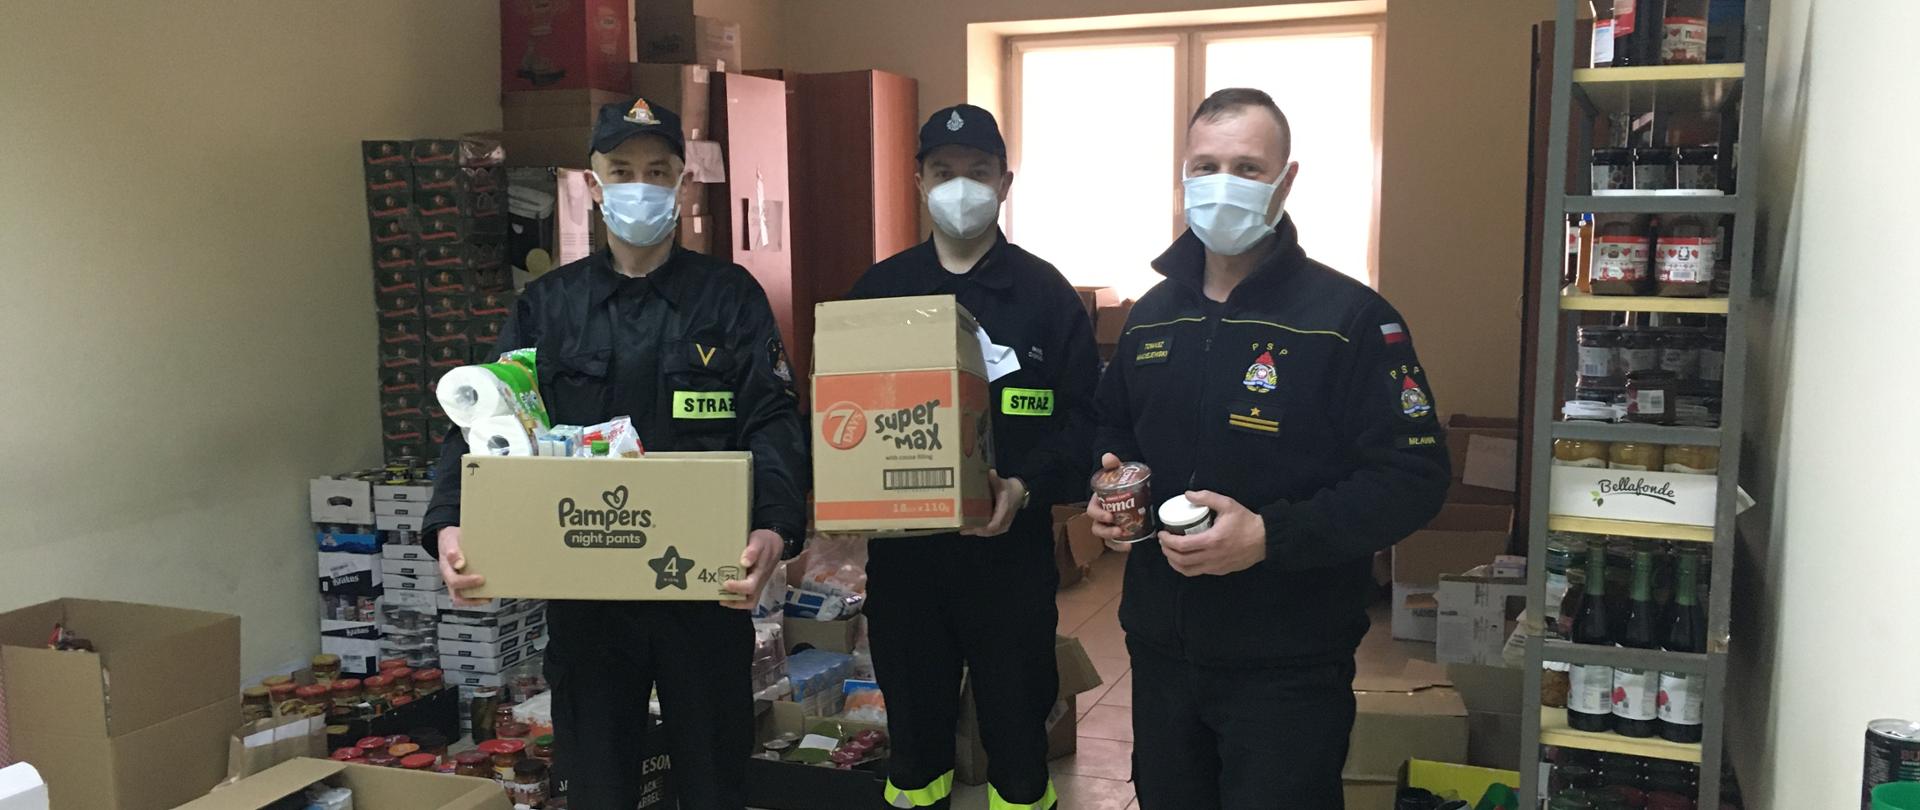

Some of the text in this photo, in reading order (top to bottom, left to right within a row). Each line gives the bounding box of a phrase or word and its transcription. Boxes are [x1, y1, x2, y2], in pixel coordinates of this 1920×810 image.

[828, 407, 857, 446] 7
[874, 399, 940, 434] super
[1598, 476, 1675, 497] Bellafonde
[558, 497, 652, 532] Pampers
[571, 532, 641, 547] night pants
[663, 556, 679, 577] 4
